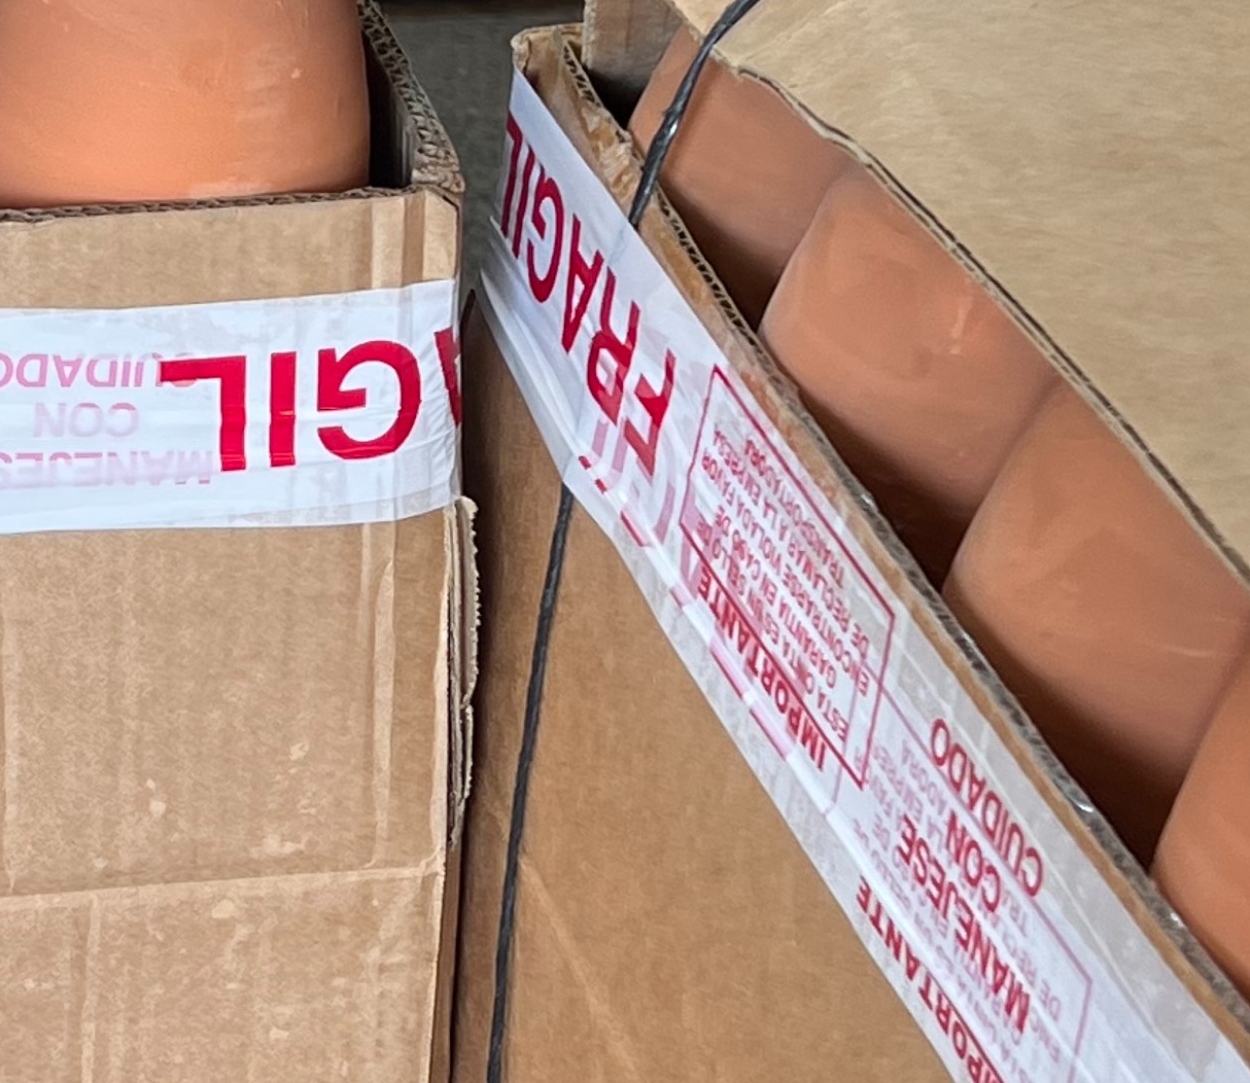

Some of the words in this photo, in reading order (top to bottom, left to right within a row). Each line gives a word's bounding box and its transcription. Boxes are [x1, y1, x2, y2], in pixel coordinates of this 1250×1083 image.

[502, 111, 675, 477] FRAGIL
[32, 403, 141, 438] CON
[713, 502, 732, 539] DE
[729, 525, 762, 583] CASO
[744, 438, 844, 588] TRANSPORTADORA
[760, 494, 778, 529] LA
[759, 569, 778, 607] EN
[781, 561, 869, 697] ENCONTRARSE
[786, 531, 851, 635] RECLAMAR
[697, 565, 825, 770] IMPORTANTE
[776, 593, 838, 692] GARANTIA
[849, 620, 870, 661] DE
[814, 684, 849, 743] ESTA
[931, 718, 1043, 897] CUIDADO
[946, 809, 1001, 913] CON
[897, 813, 1030, 1034] MANEJESE
